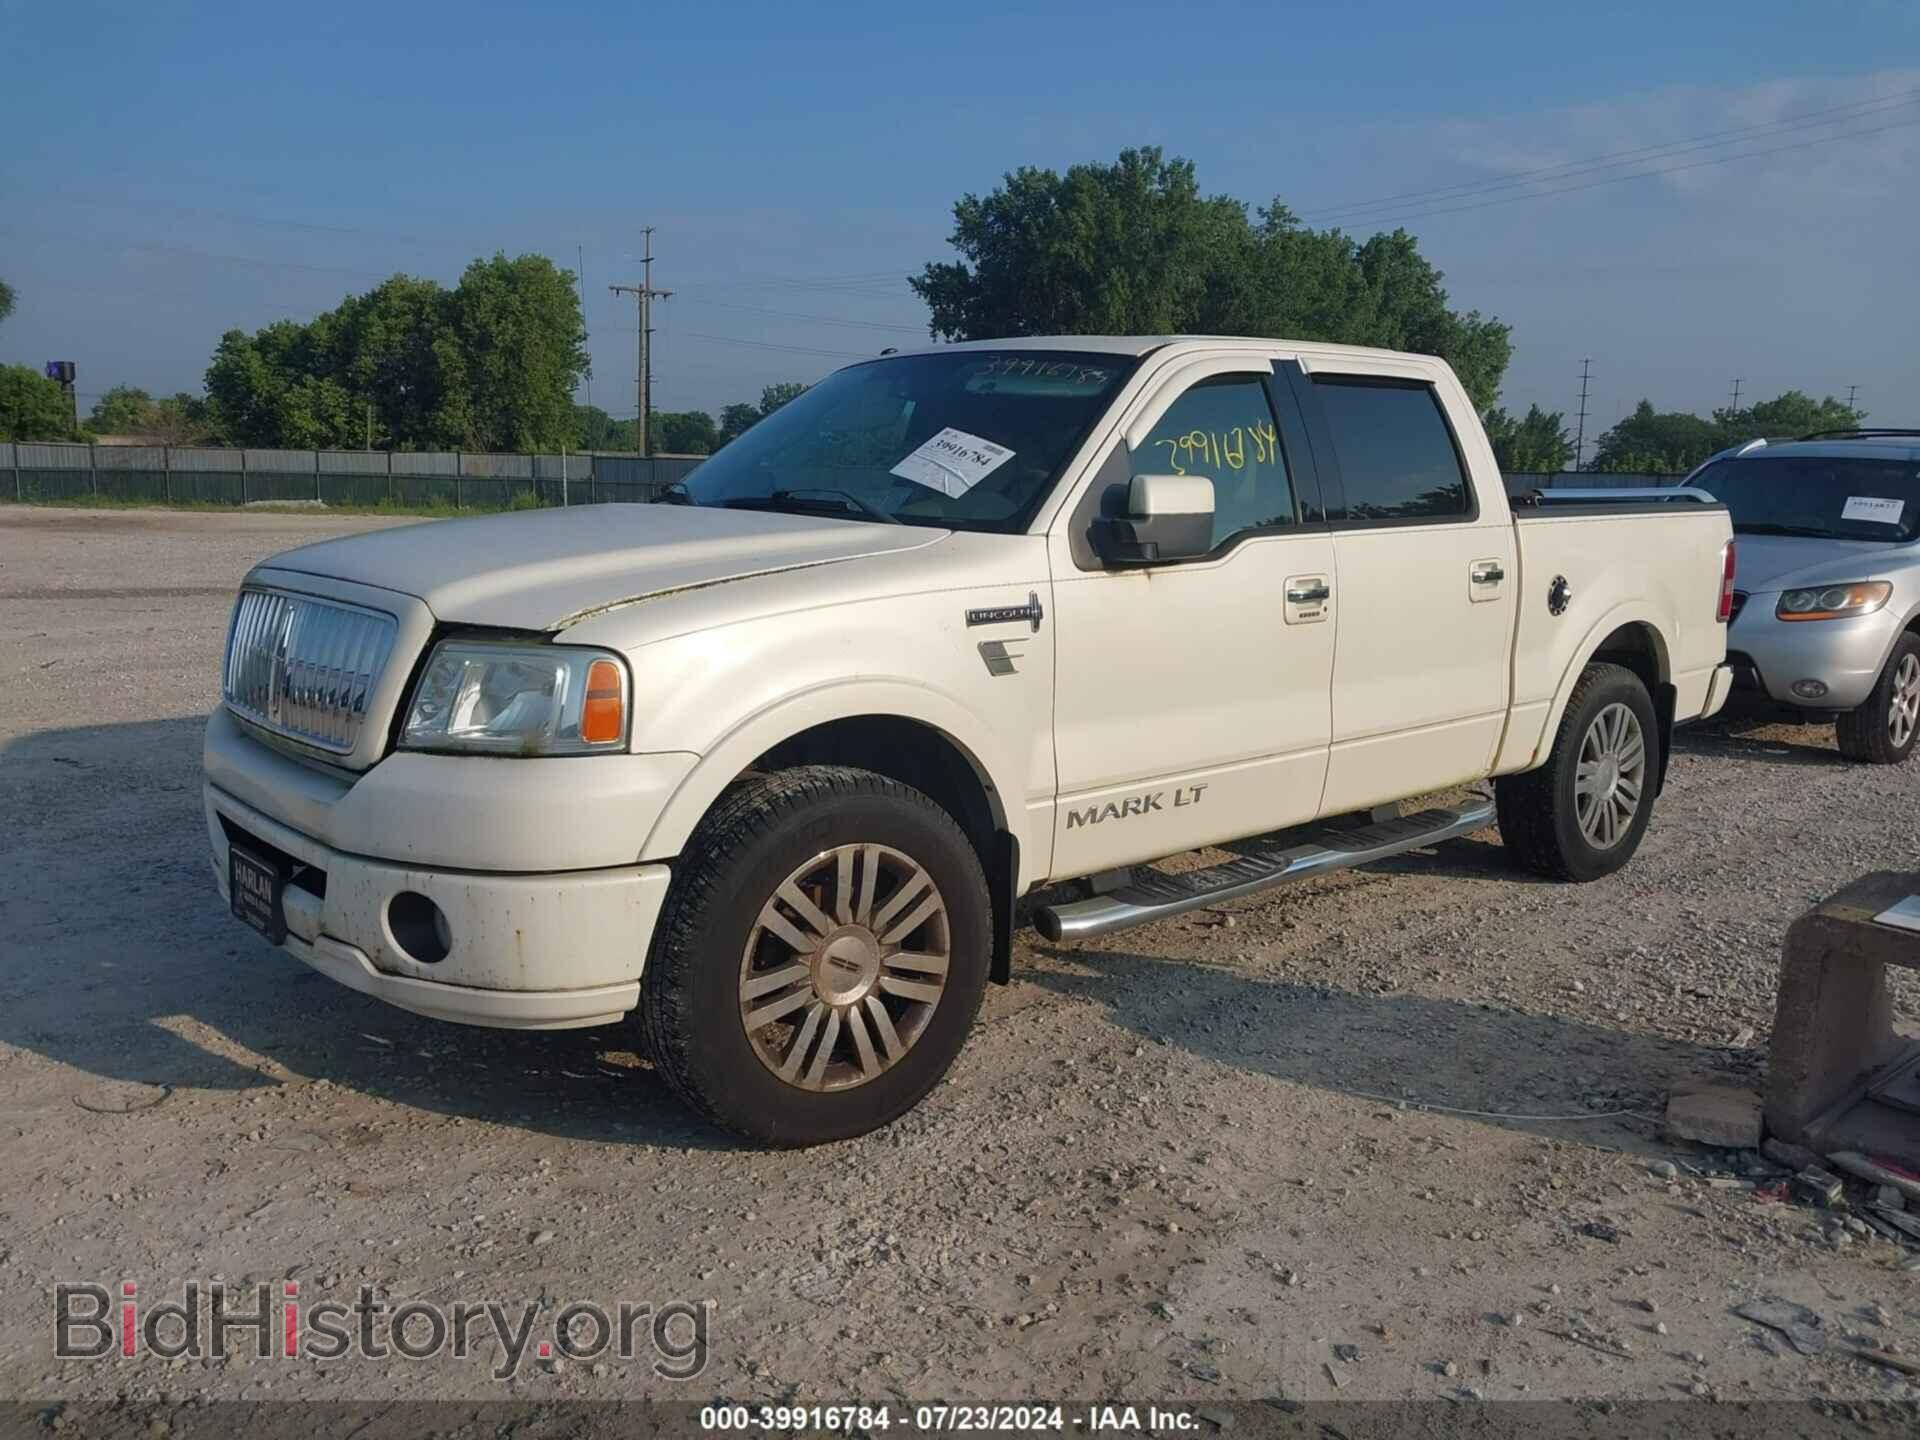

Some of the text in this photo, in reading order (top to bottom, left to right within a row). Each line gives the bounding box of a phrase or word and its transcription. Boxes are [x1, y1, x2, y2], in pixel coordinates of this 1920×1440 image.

[933, 438, 993, 466] 39916784
[1066, 783, 1208, 829] MARK LT
[234, 859, 272, 905] HARLAN
